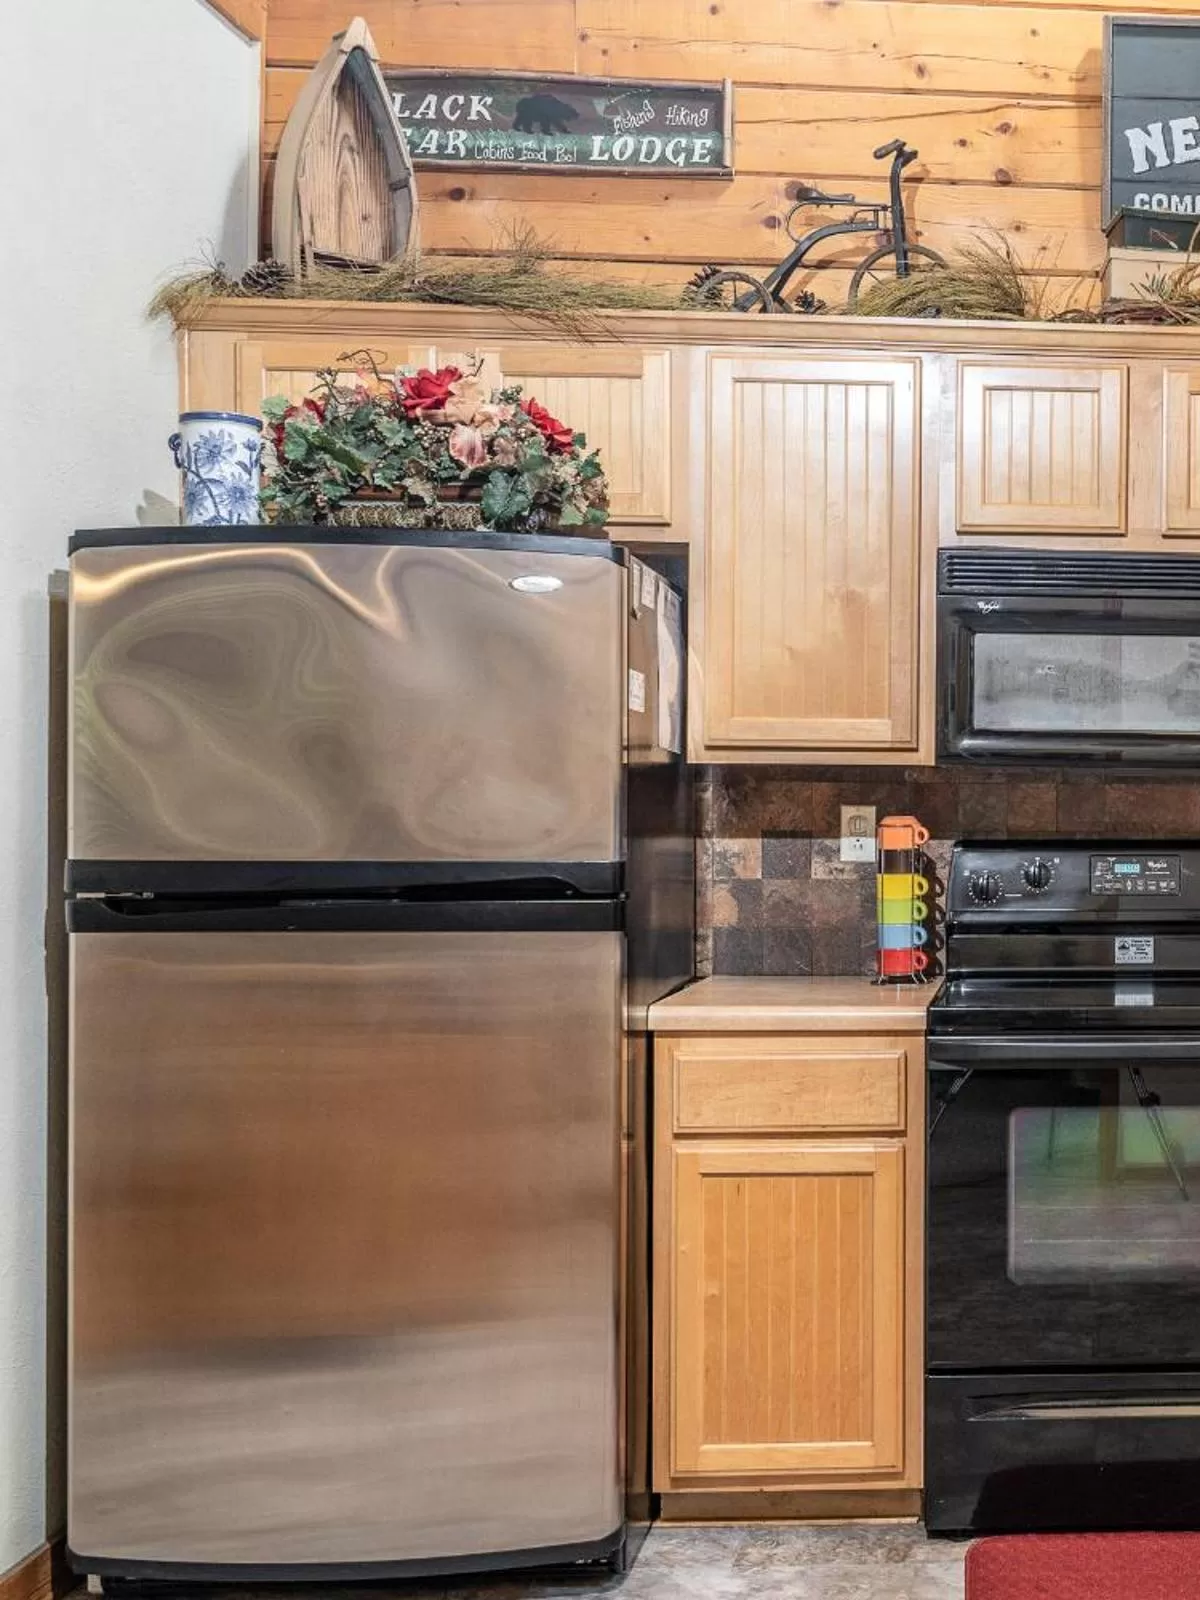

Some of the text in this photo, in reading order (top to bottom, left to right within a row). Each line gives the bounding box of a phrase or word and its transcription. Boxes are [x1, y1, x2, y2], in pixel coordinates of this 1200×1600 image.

[391, 92, 493, 121] LACK
[666, 105, 709, 127] Hiking
[474, 140, 514, 159] Cabins
[589, 135, 713, 167] LODGE
